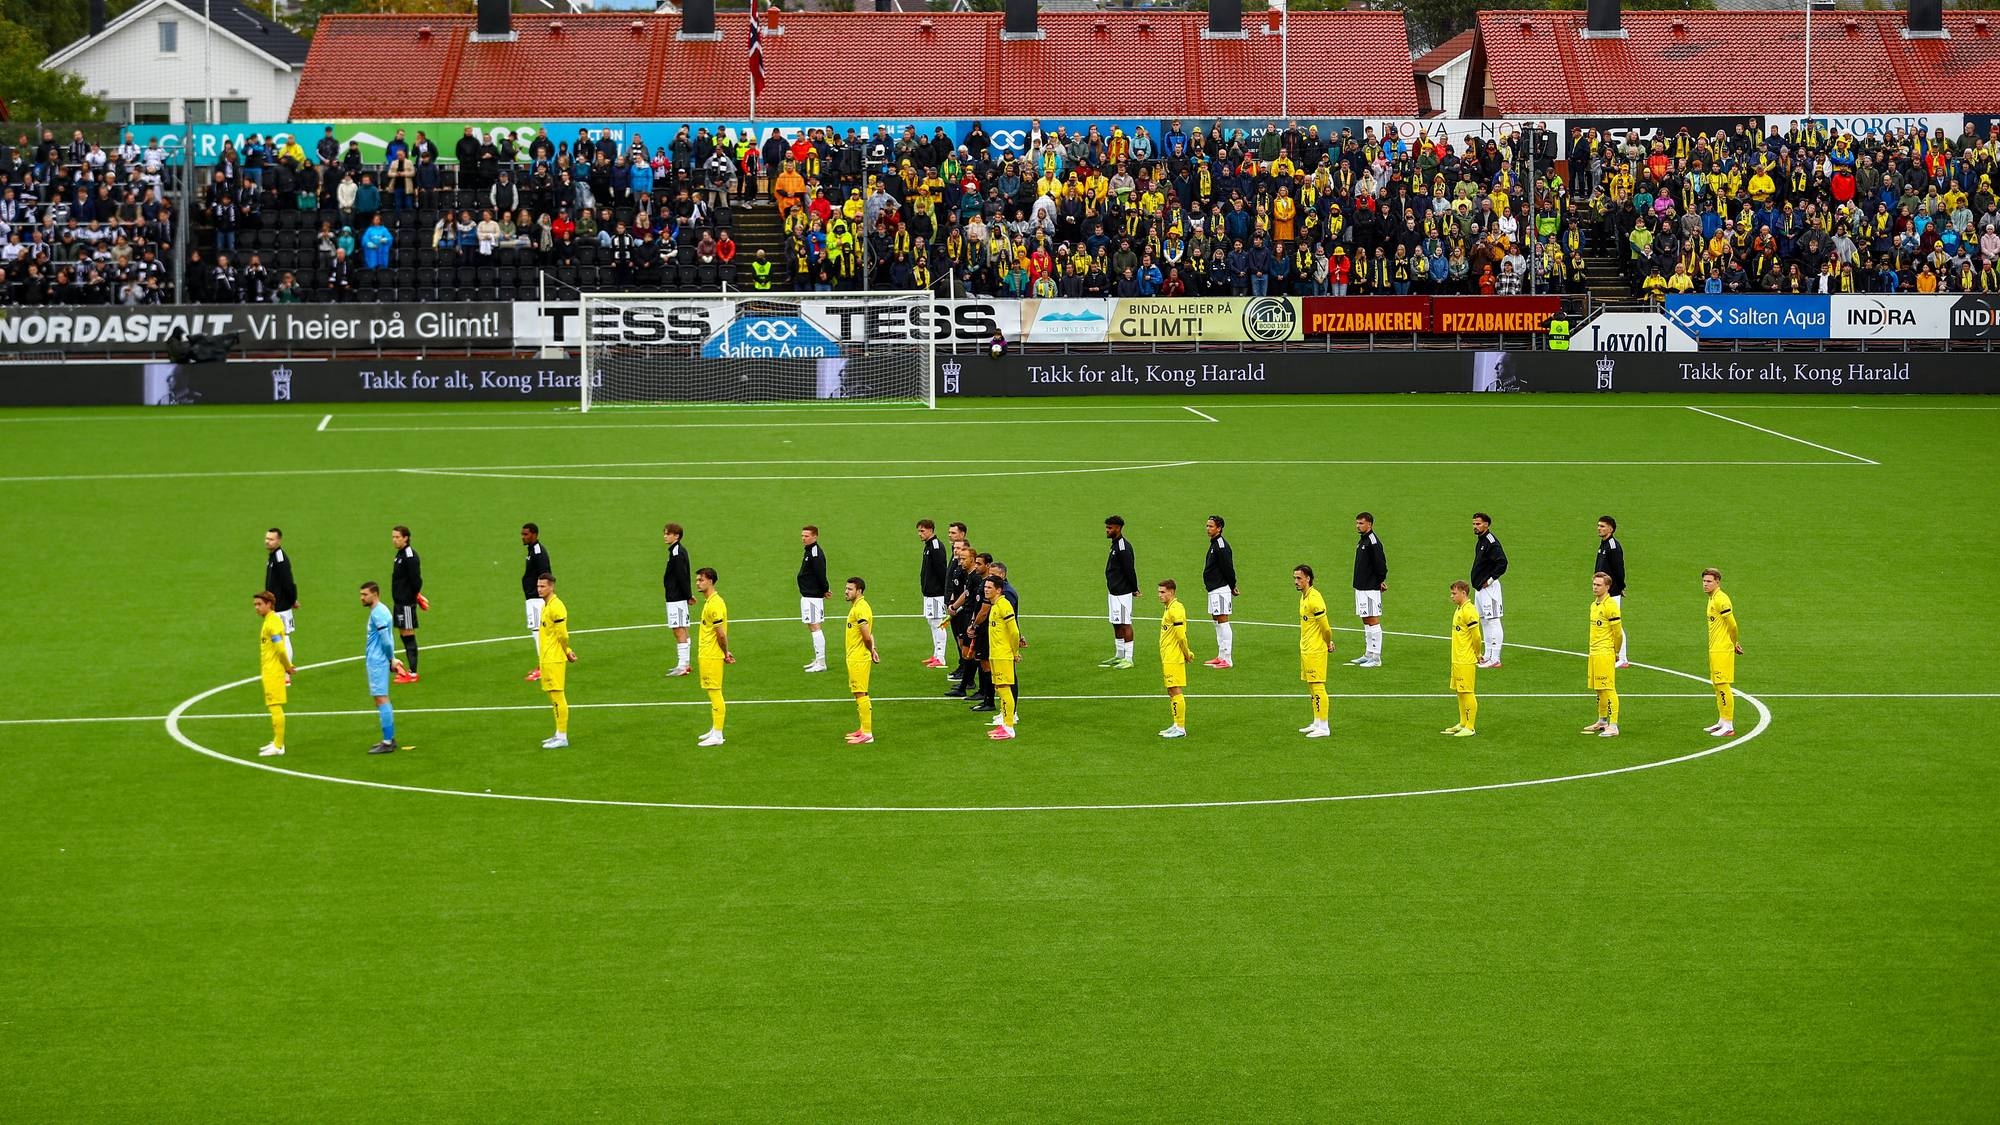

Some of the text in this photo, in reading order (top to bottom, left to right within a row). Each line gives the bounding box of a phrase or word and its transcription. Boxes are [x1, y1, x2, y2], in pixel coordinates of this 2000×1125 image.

[1833, 117, 1929, 137] NORGES
[1129, 301, 1232, 315] BINDAL HEIER PÅ
[1728, 308, 1826, 330] Salten Aqua
[247, 314, 277, 340] Vi
[287, 314, 361, 340] heier
[370, 311, 405, 344] på
[415, 311, 500, 339] Glimt!
[538, 307, 711, 342] TESS
[825, 304, 996, 341] TESS
[1119, 317, 1203, 338] GLIMT!
[1312, 312, 1422, 332] PIZZABAKEREN
[719, 341, 775, 358] Salten
[1592, 325, 1667, 351] Løvold
[360, 369, 603, 393] Takk for alt, Kong Harad
[1028, 363, 1266, 387] Takk for alt, Kong Harald
[1679, 361, 1910, 387] Takk for alt, Kong Harald
